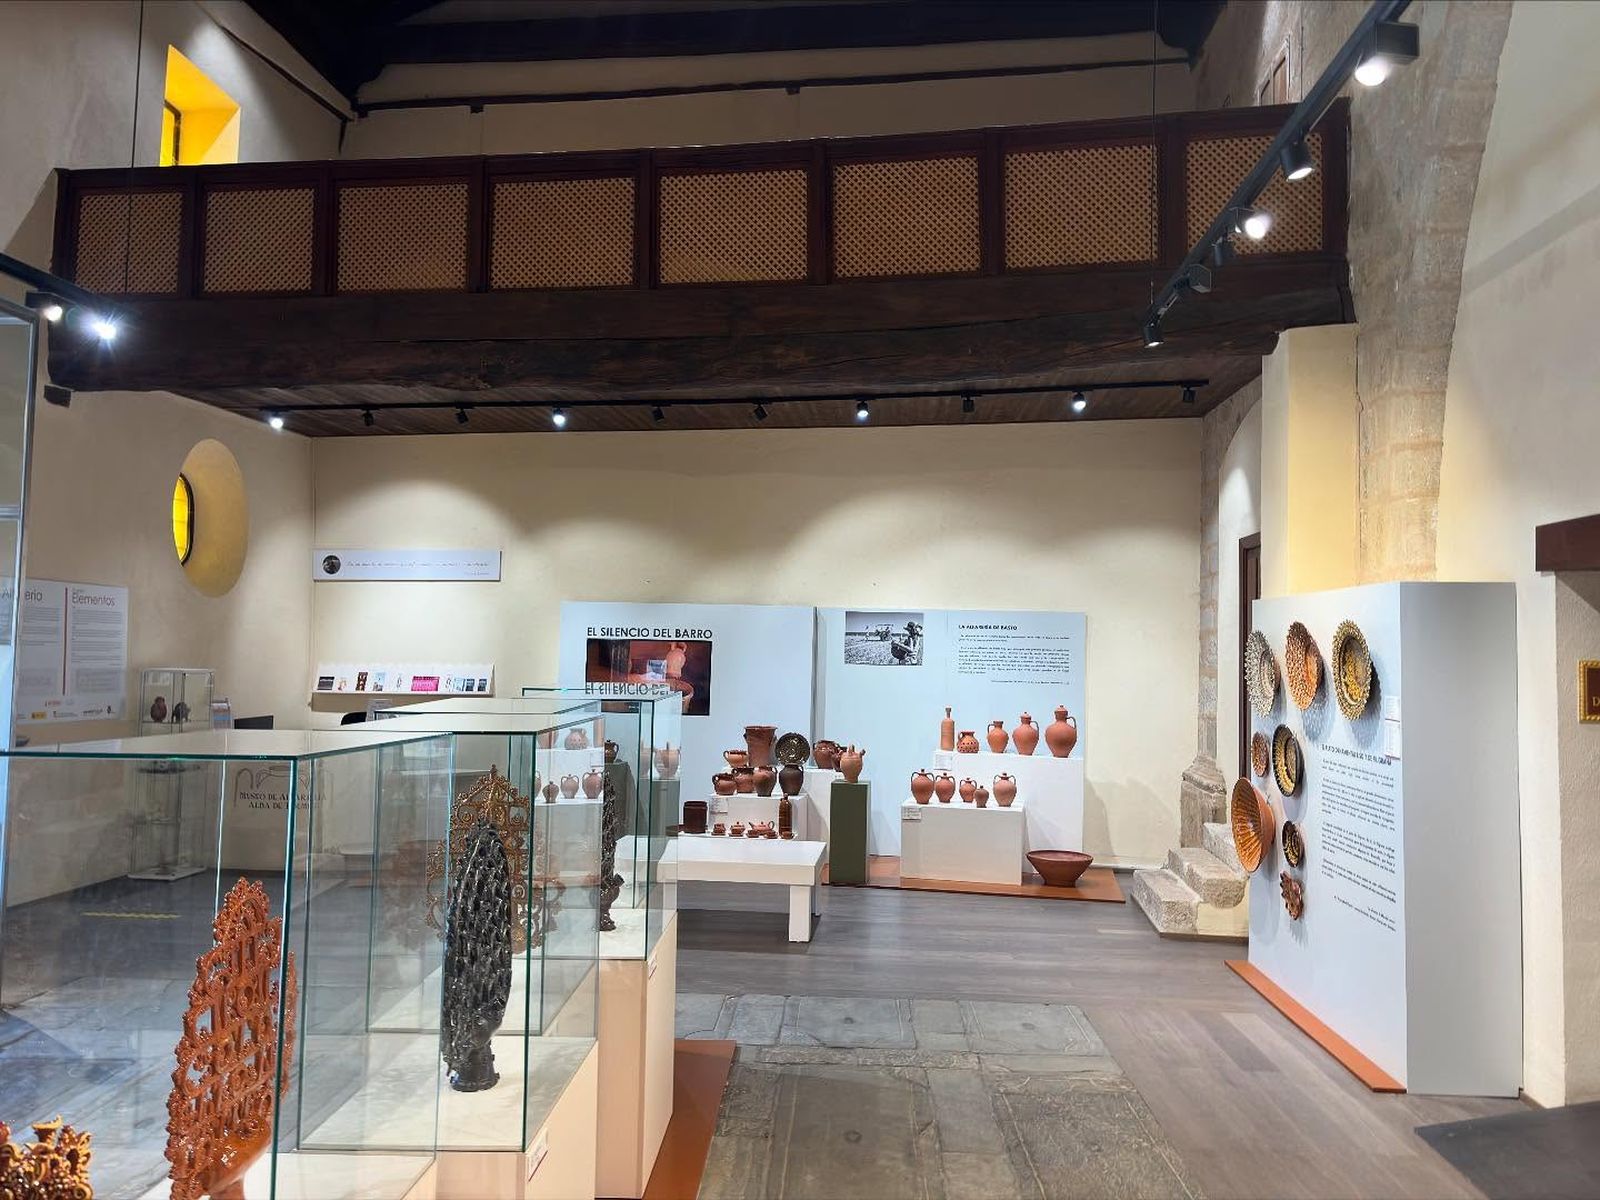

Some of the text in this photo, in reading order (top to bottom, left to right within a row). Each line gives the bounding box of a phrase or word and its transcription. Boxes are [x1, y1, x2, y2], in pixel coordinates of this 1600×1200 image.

[587, 627, 713, 639] EL SILENCIO DEL BARRO
